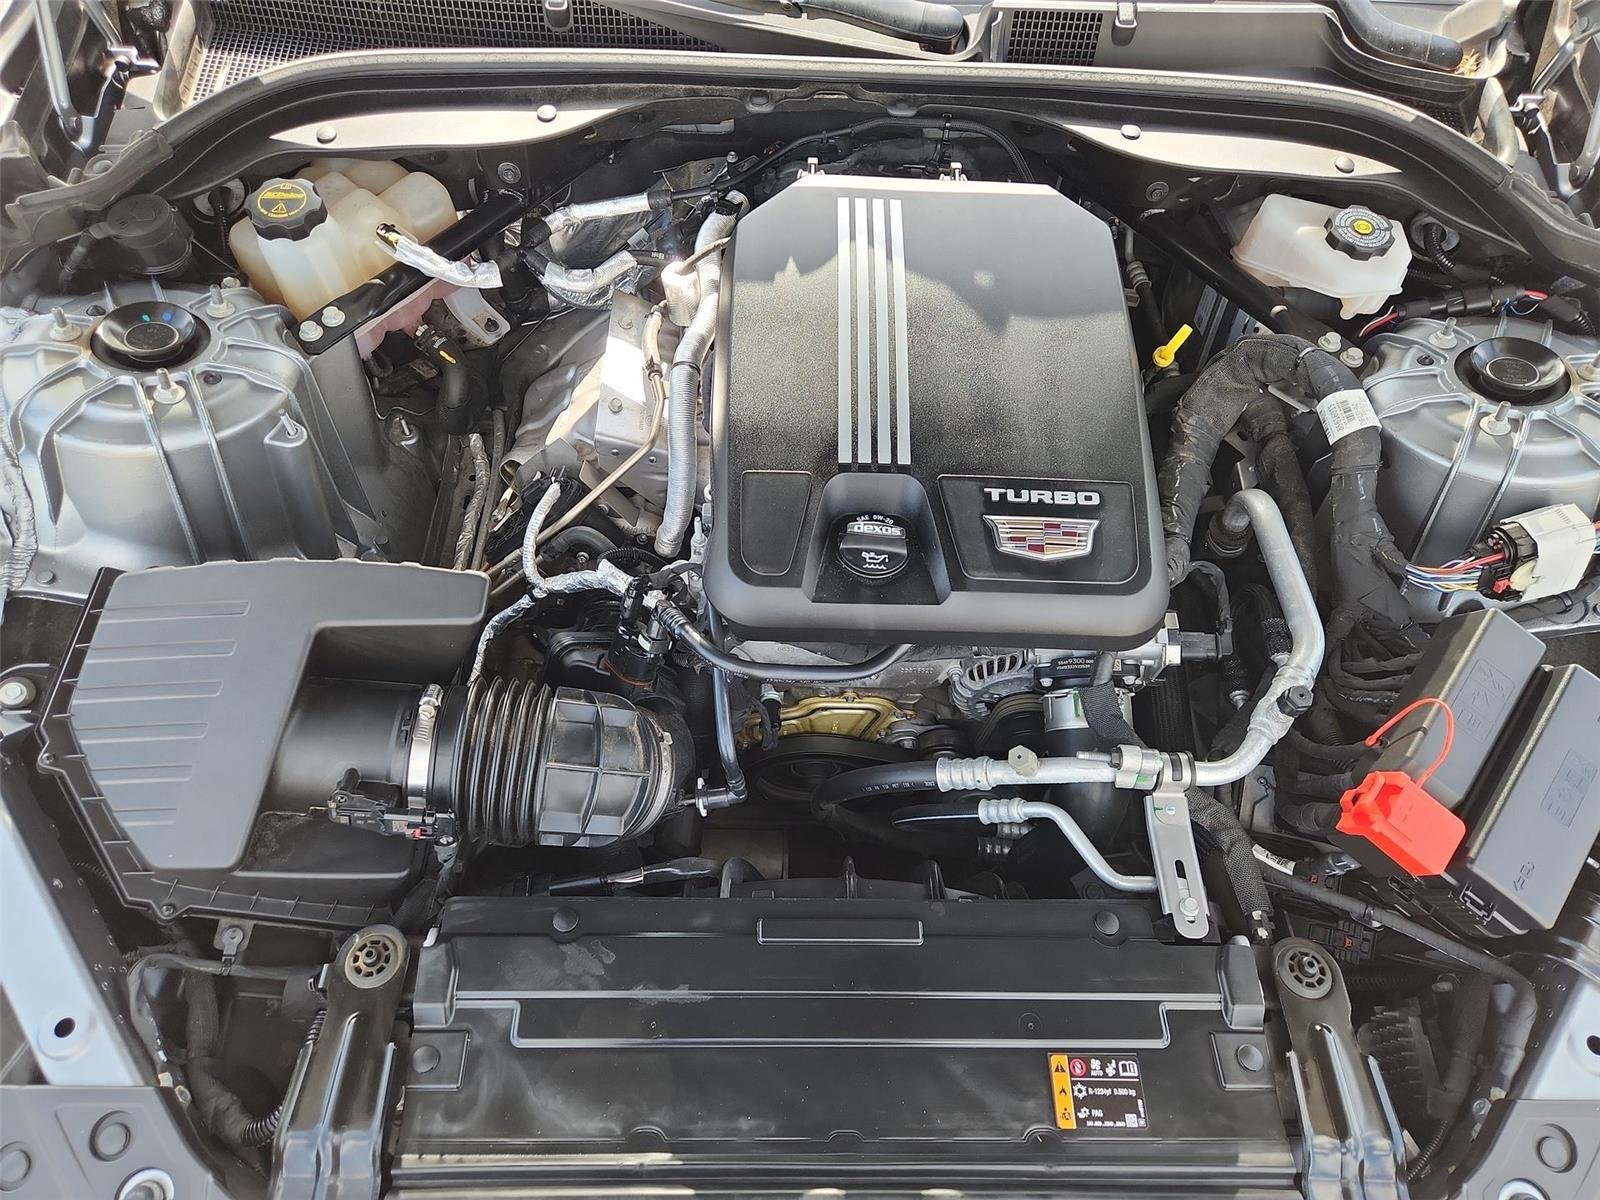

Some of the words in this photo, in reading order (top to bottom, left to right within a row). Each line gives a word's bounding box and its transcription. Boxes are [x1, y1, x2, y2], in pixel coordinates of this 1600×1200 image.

[983, 487, 1101, 505] TURBO
[853, 521, 902, 536] dexos
[1091, 1109, 1104, 1117] PAG
